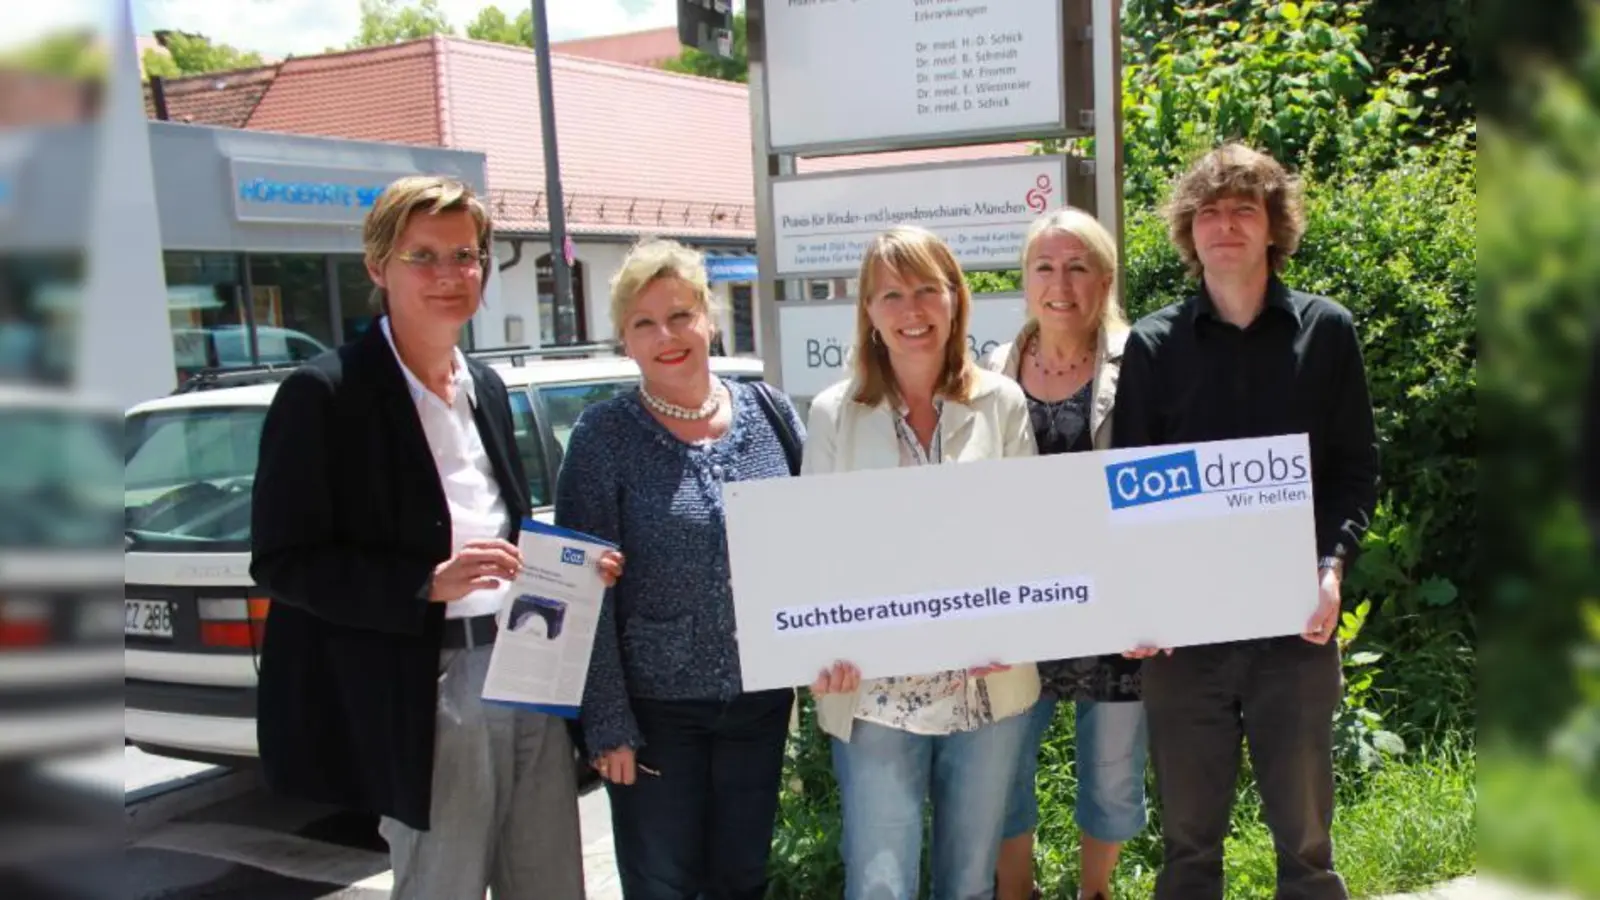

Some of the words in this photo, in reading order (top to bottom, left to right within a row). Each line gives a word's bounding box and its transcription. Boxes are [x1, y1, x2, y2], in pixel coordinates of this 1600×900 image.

[933, 40, 957, 51] med.
[990, 32, 1023, 46] Schick
[933, 54, 958, 66] med.
[975, 49, 1018, 63] Schmidt
[934, 69, 959, 81] med.
[934, 86, 960, 97] med.
[934, 101, 960, 113] med.
[977, 96, 1010, 109] Schick
[782, 214, 810, 228] Praxis
[812, 212, 825, 228] für
[864, 207, 884, 223] und
[884, 204, 971, 227] Jugendpsychiatrie
[974, 200, 1027, 214] München
[1226, 493, 1254, 508] Wir
[776, 587, 1012, 631] Suchtberatungsstelle
[1018, 582, 1089, 604] Pasing
